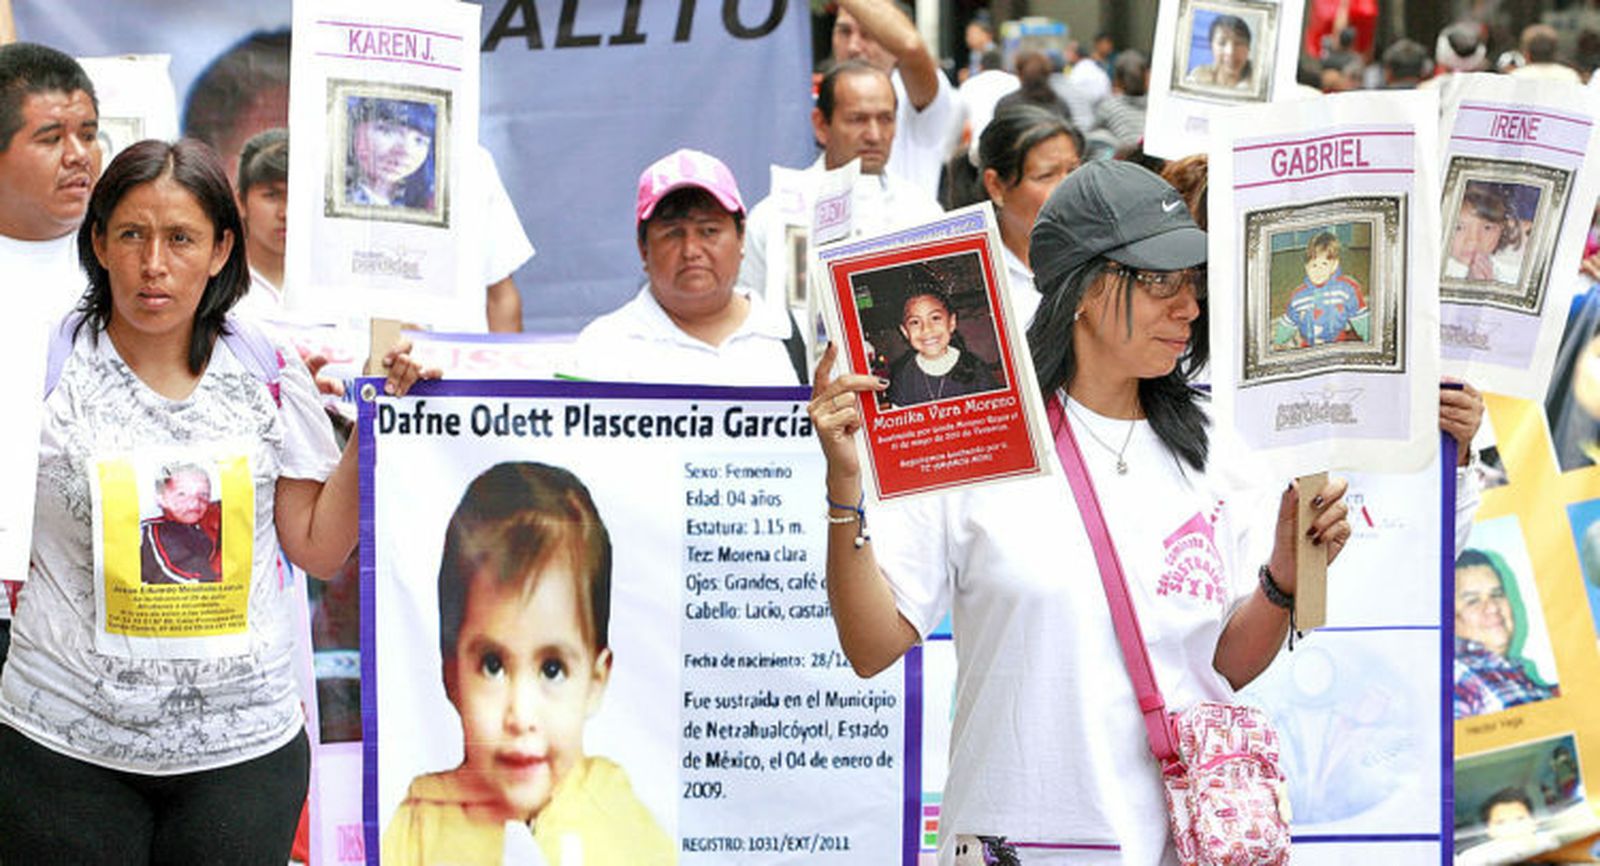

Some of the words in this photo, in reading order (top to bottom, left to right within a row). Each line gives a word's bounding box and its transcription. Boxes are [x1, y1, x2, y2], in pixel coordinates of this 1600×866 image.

[348, 29, 418, 58] KAREN
[422, 37, 435, 61] J.
[1490, 115, 1542, 141] IRENE
[1271, 139, 1370, 177] GABRIEL
[378, 401, 461, 436] Dafne
[470, 403, 553, 437] Odett
[564, 403, 714, 438] Plascencia
[724, 404, 813, 438] García
[873, 411, 925, 431] Monika
[928, 404, 961, 420] Vera
[964, 396, 1017, 414] Moreno
[684, 462, 722, 478] Sexo:
[725, 462, 792, 478] Femenino
[686, 489, 723, 506] Edad:
[726, 490, 747, 506] 04
[751, 489, 782, 507] años
[686, 518, 748, 535] Estatura:
[754, 518, 784, 535] 1.15
[789, 522, 806, 535] m.
[686, 546, 713, 562] Tez:
[718, 546, 770, 562] Morena
[774, 546, 807, 561] clara
[686, 572, 720, 595] Ojos:
[725, 573, 784, 592] Grandes,
[788, 572, 818, 590] café
[686, 601, 741, 619] Cabello:
[746, 601, 785, 621] Lacio,
[684, 653, 718, 668] Fecha
[721, 653, 735, 668] de
[738, 653, 805, 668] nacimiento:
[684, 691, 711, 708] Fue
[784, 694, 801, 708] en
[806, 689, 820, 708] el
[825, 690, 897, 712] Municipio
[683, 720, 700, 739] de
[706, 720, 833, 743] Netzahualcóyotl,
[838, 720, 889, 739] Estado
[682, 751, 700, 770] de
[705, 751, 765, 771] México,
[769, 751, 782, 770] el
[786, 751, 806, 769] 04
[810, 751, 828, 769] de
[832, 756, 872, 768] enero
[876, 751, 893, 768] de
[683, 782, 727, 799] 2009.
[682, 837, 746, 851] REGISTRO:
[749, 834, 850, 853] 1031/EXT/2011
